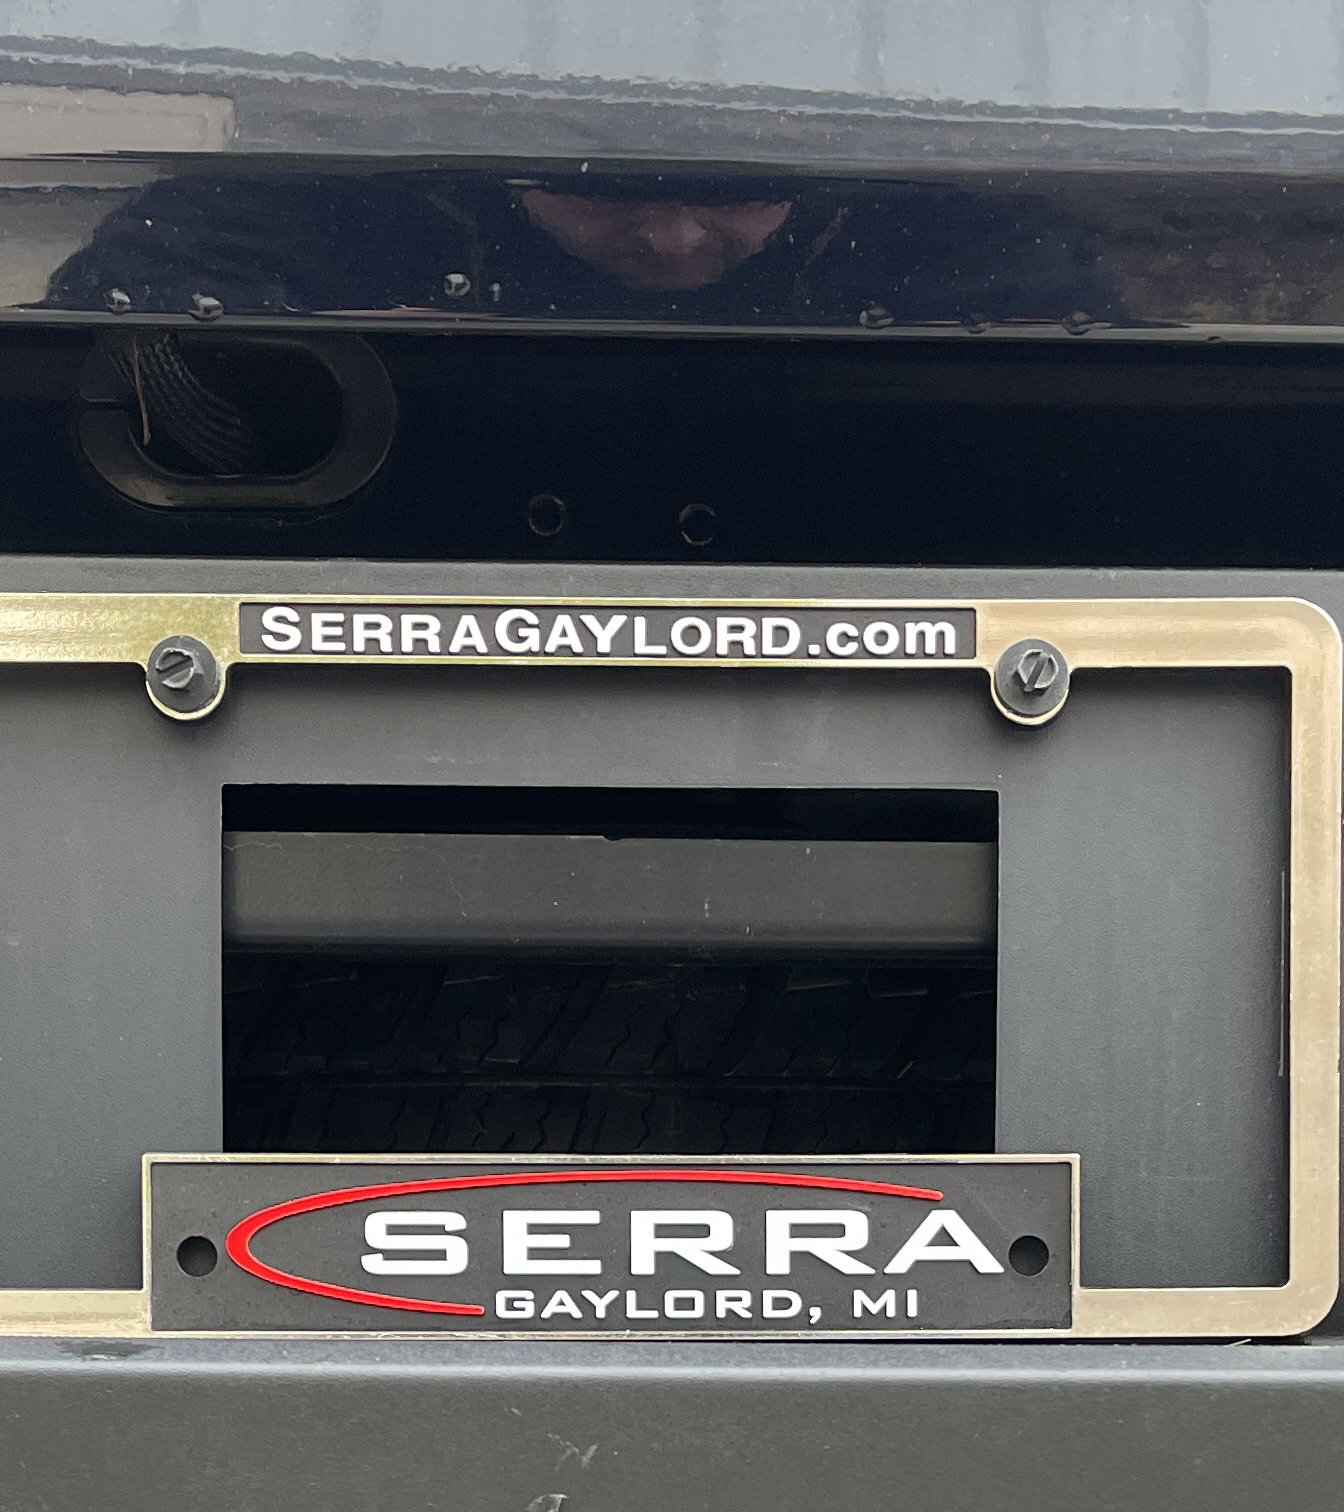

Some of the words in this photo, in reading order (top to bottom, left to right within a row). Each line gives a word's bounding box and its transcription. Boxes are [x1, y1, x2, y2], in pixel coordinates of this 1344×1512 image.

[360, 1209, 1005, 1276] SERRA
[494, 1288, 824, 1324] GAYLORD,
[852, 1289, 920, 1318] MI
